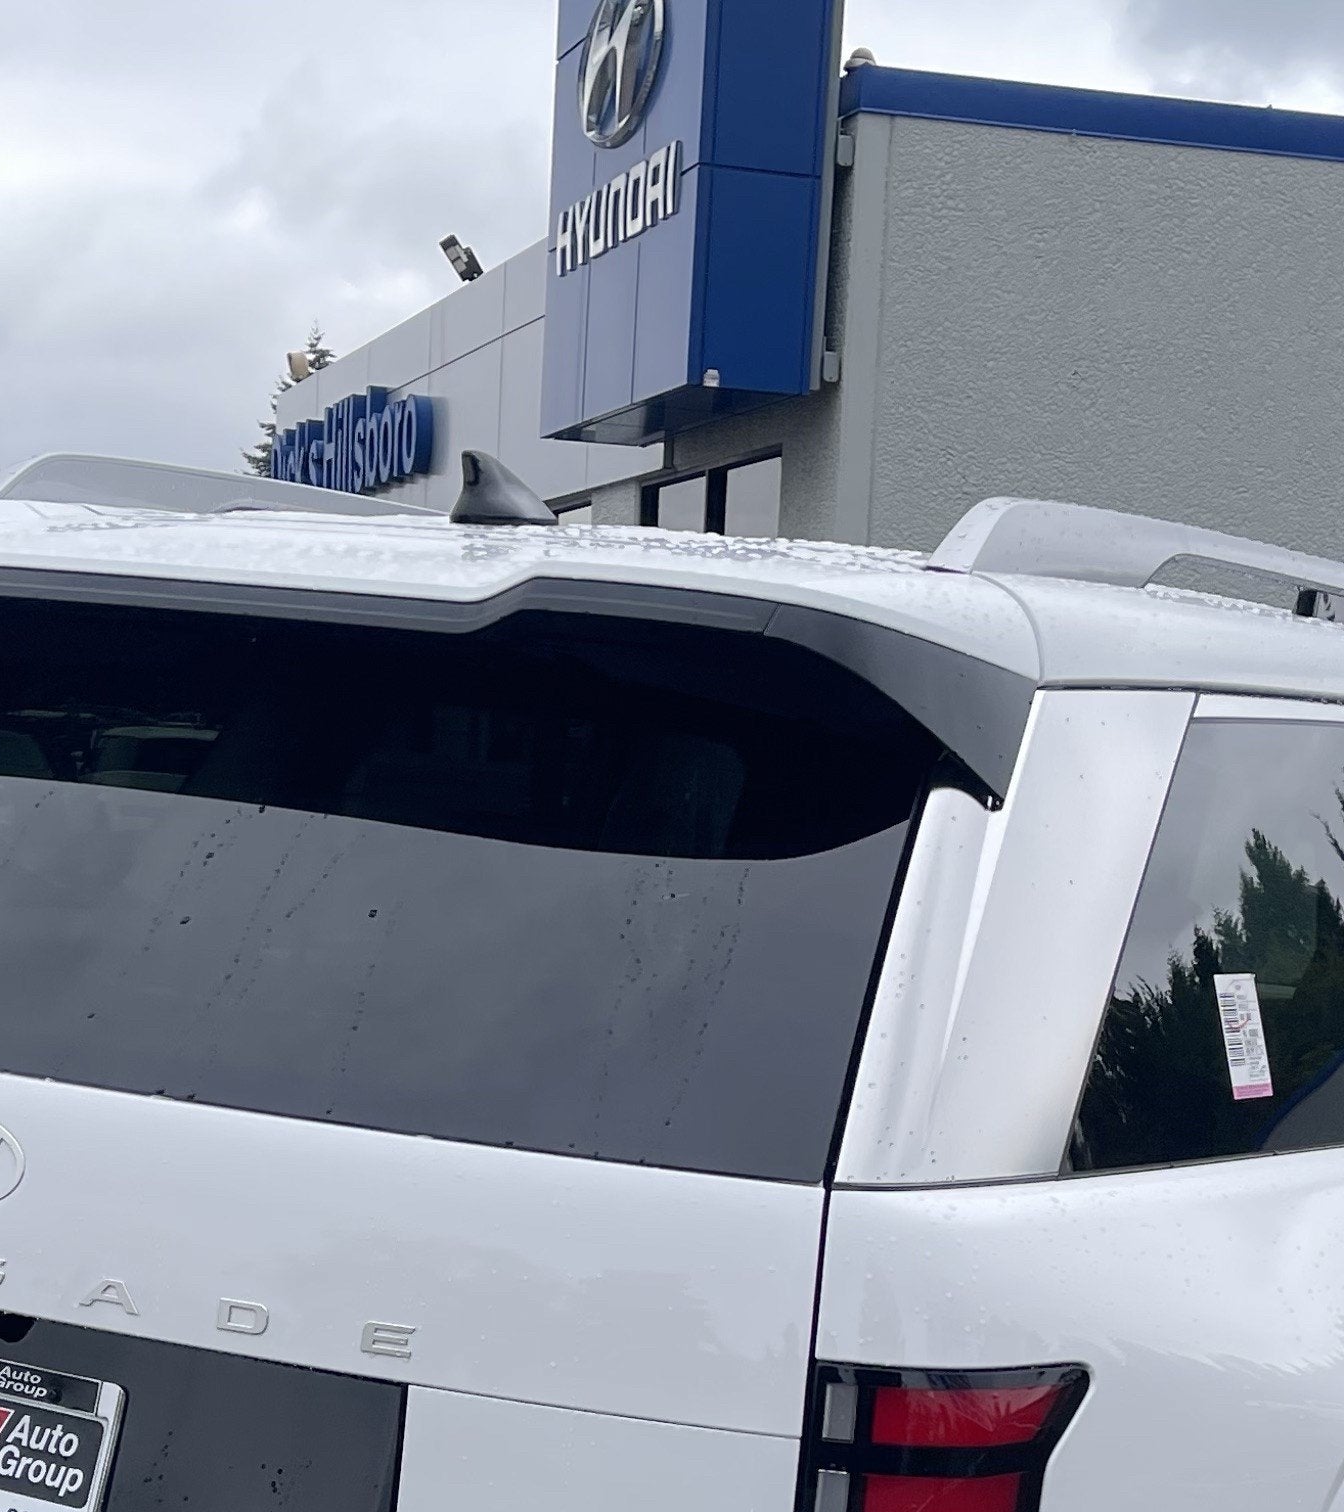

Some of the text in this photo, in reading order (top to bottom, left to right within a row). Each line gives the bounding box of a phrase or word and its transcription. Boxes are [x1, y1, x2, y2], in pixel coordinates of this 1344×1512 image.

[556, 140, 683, 277] HYUNDAI
[323, 387, 418, 493] Hillsboro
[6, 1415, 80, 1458] Auto
